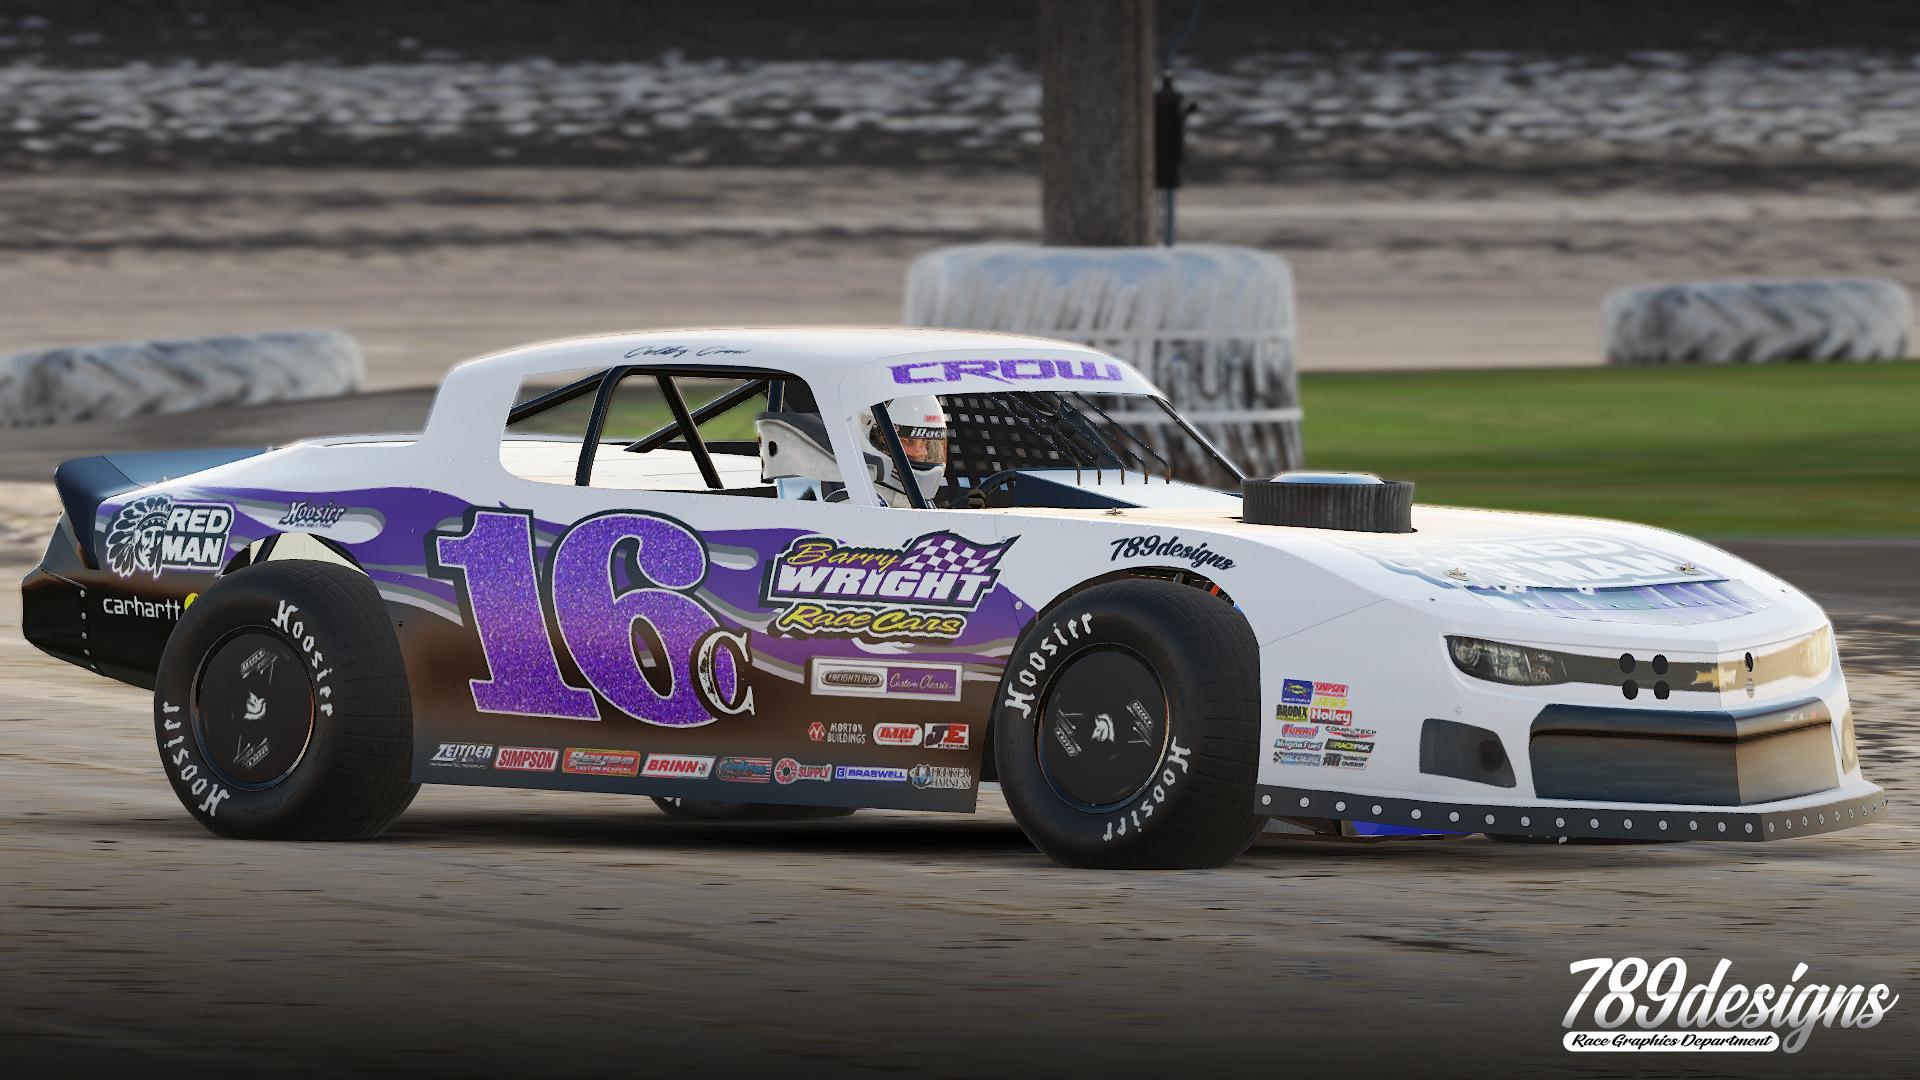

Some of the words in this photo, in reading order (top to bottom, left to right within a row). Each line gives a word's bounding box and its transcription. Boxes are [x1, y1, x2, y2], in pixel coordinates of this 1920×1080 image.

[885, 357, 1124, 385] CROW
[168, 508, 230, 534] RED
[278, 501, 346, 525] Hoosier
[161, 536, 224, 564] MAN
[787, 542, 900, 572] Barry
[1110, 534, 1236, 571] 789designs
[776, 564, 991, 601] WRIGHT
[103, 595, 181, 621] carhartt
[781, 605, 870, 629] Race
[870, 609, 965, 634] Cars
[271, 600, 333, 718] Hoosier
[1004, 612, 1093, 720] Hoosier
[826, 671, 878, 683] FREIGHTLINER
[830, 722, 863, 733] MORTON
[1311, 708, 1351, 725] Holley
[827, 733, 867, 745] BUILDINGS
[924, 725, 967, 746] JE
[163, 701, 230, 817] Hoosier
[499, 749, 556, 769] SIMPSON
[647, 759, 699, 773] BRINN
[799, 766, 831, 778] SUPPLY
[848, 769, 906, 779] BRASWELL
[1103, 736, 1192, 842] Hoosier
